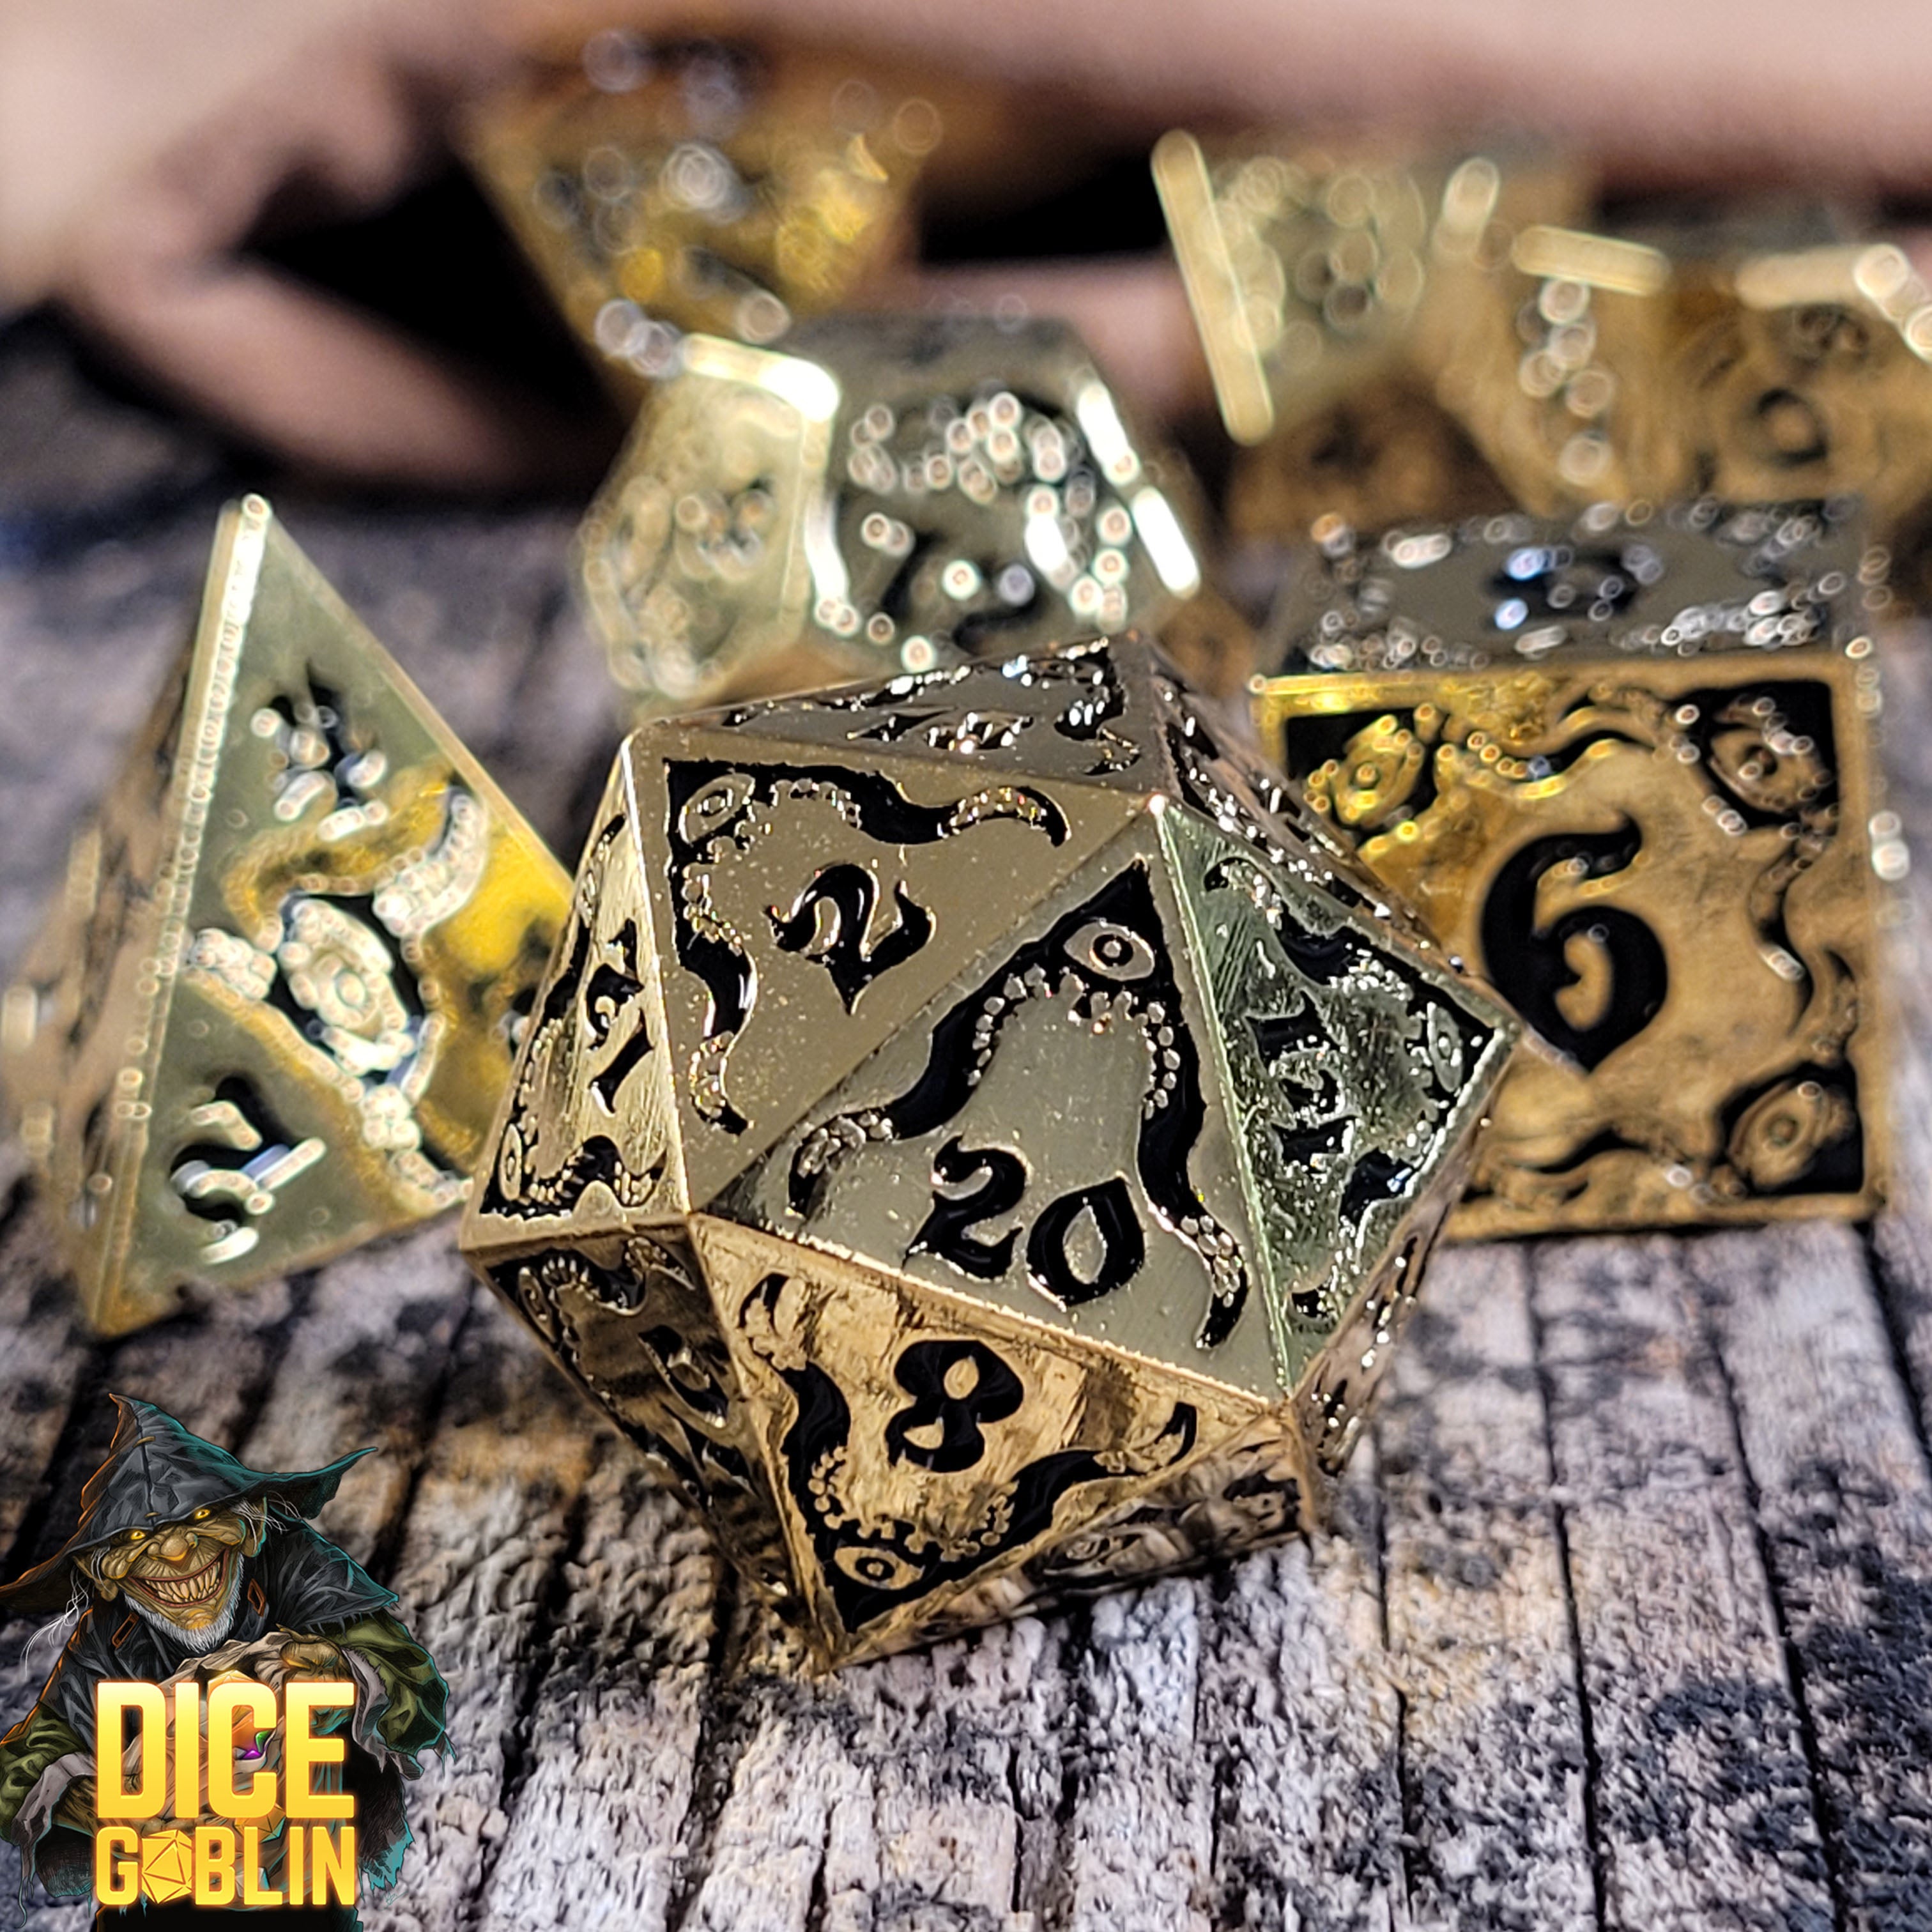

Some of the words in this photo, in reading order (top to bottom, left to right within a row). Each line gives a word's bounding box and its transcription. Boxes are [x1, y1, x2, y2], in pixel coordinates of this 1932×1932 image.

[764, 861, 937, 1016] 2
[1481, 810, 1667, 1075] 6
[902, 1135, 1145, 1310] 20
[885, 1339, 1024, 1473] 8
